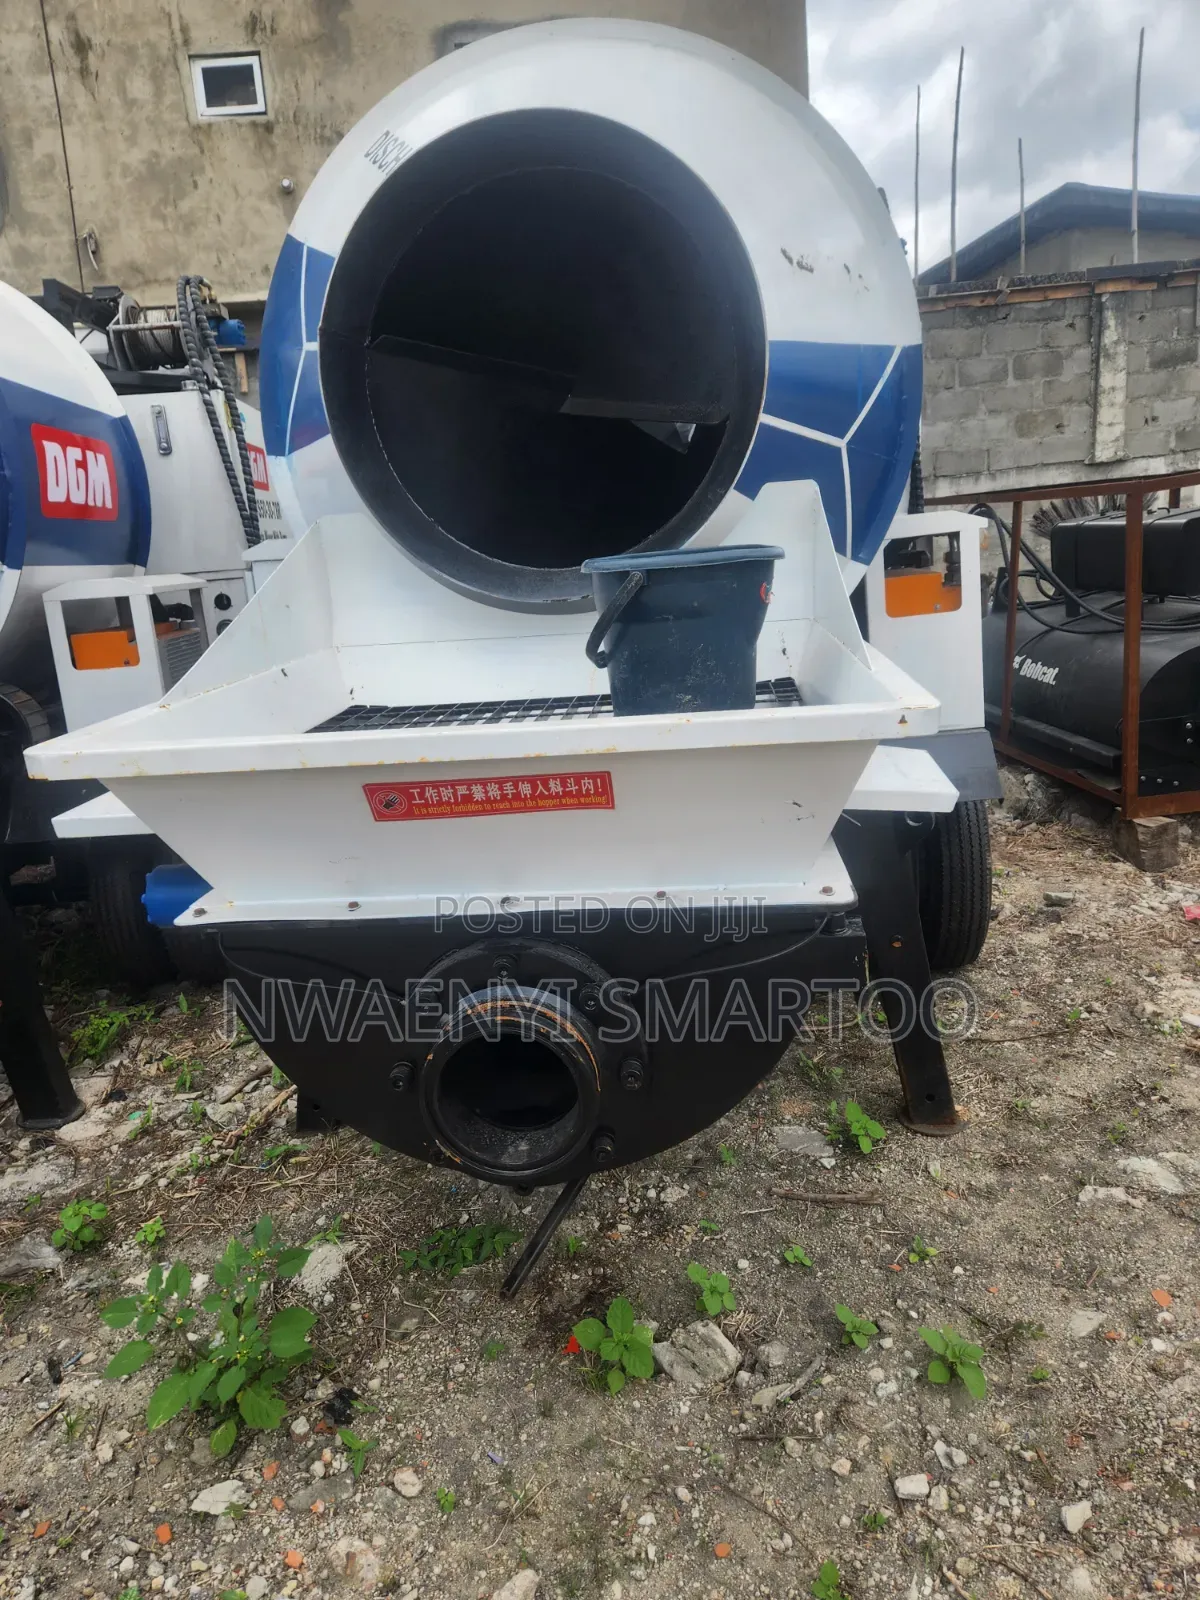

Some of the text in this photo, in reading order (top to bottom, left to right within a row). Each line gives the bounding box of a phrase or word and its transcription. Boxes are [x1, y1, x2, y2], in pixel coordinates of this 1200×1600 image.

[41, 439, 113, 509] DGM
[248, 450, 268, 485] GM
[1020, 658, 1059, 685] Bobcat
[413, 806, 418, 815] It
[421, 806, 427, 814] is
[428, 804, 451, 814] strictly
[452, 802, 483, 813] forbidden
[492, 800, 511, 810] reach
[512, 799, 524, 808] into
[526, 799, 536, 807] the
[538, 797, 560, 807] hopper
[561, 796, 579, 805] when
[580, 794, 608, 805] working!
